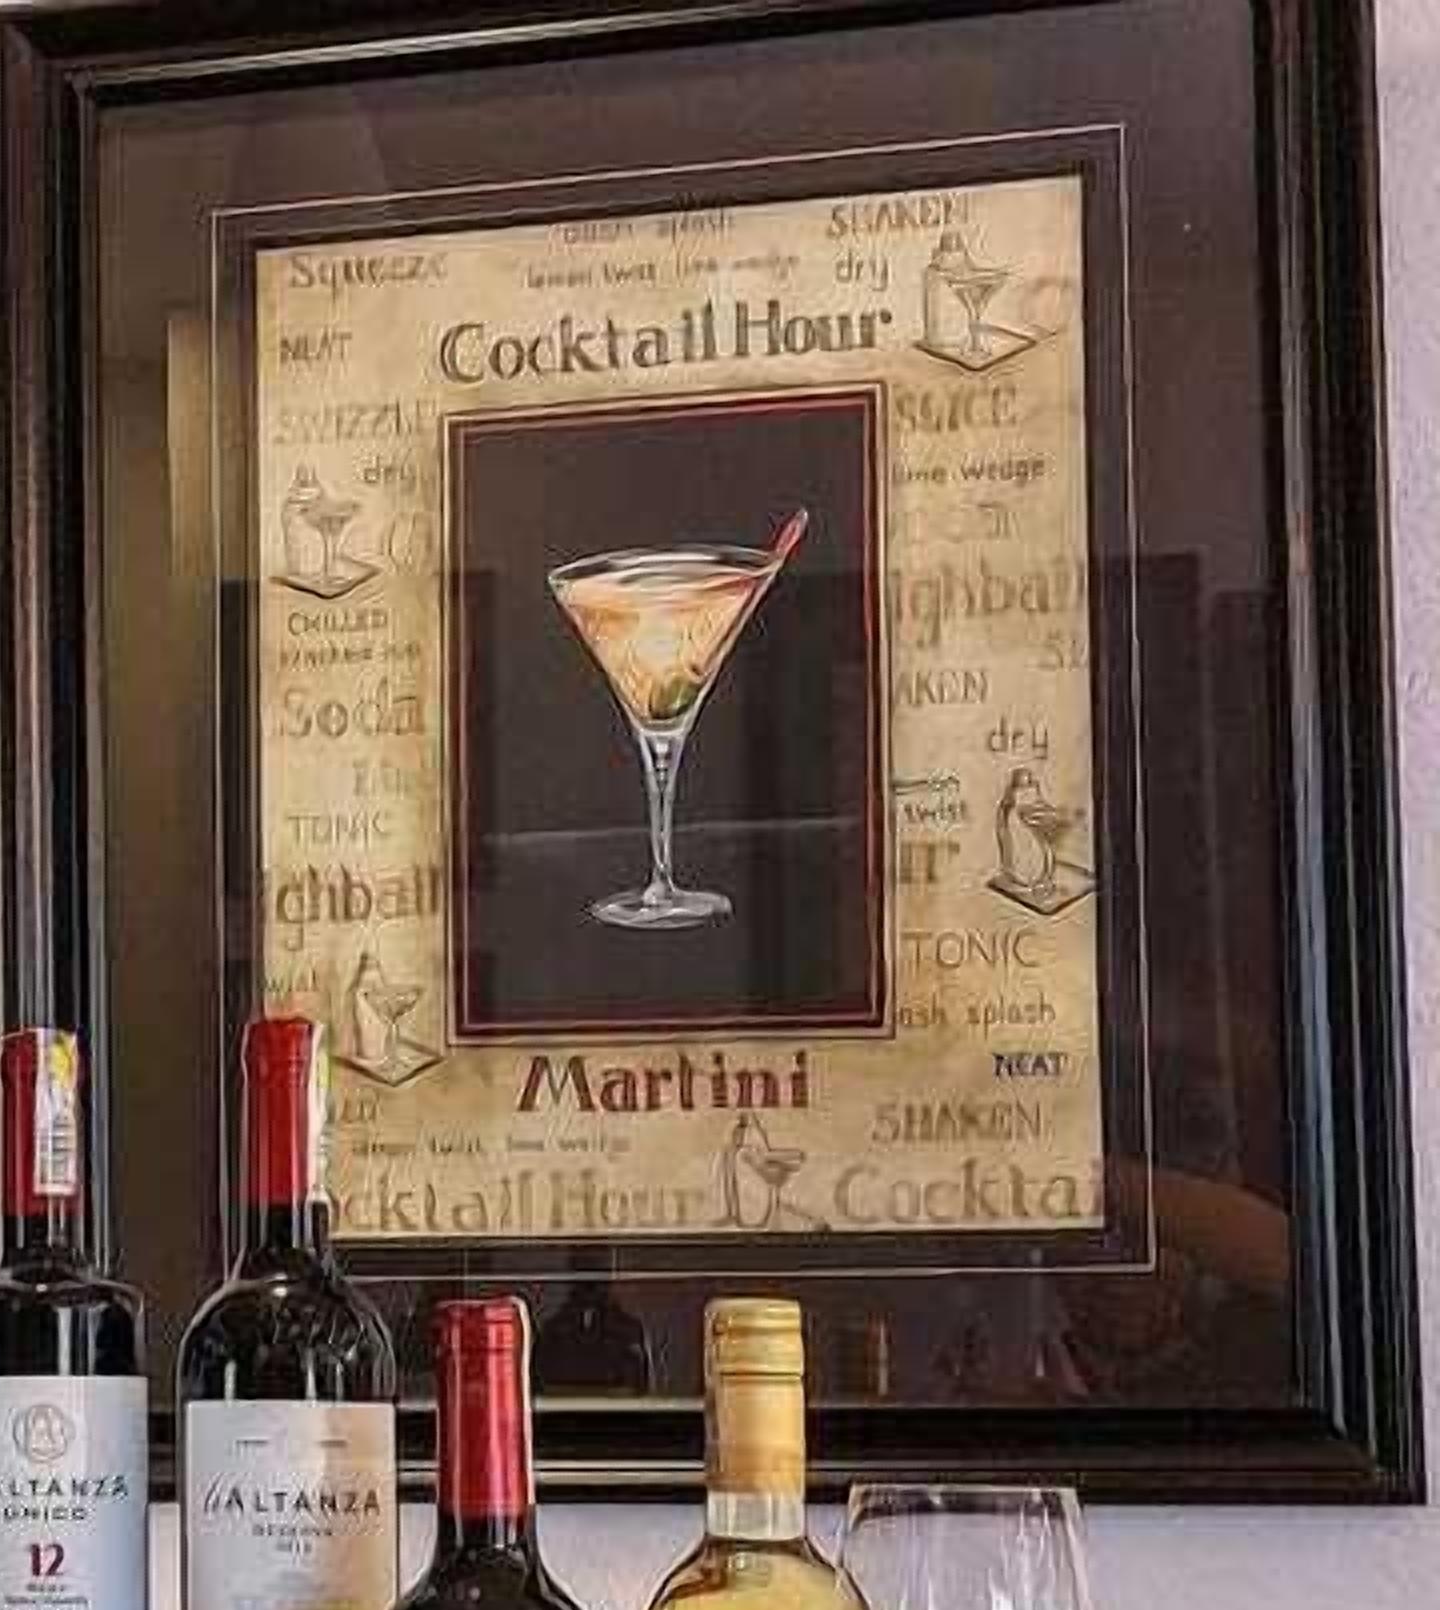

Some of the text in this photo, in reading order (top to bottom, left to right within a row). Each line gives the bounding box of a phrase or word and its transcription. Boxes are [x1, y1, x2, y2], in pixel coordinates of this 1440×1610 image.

[833, 250, 890, 291] dry
[439, 297, 893, 384] Cocktail Hour
[988, 714, 1049, 760] dry
[900, 929, 1041, 971] TONIC
[517, 1050, 808, 1112] Martini
[27, 1543, 65, 1577] 12
